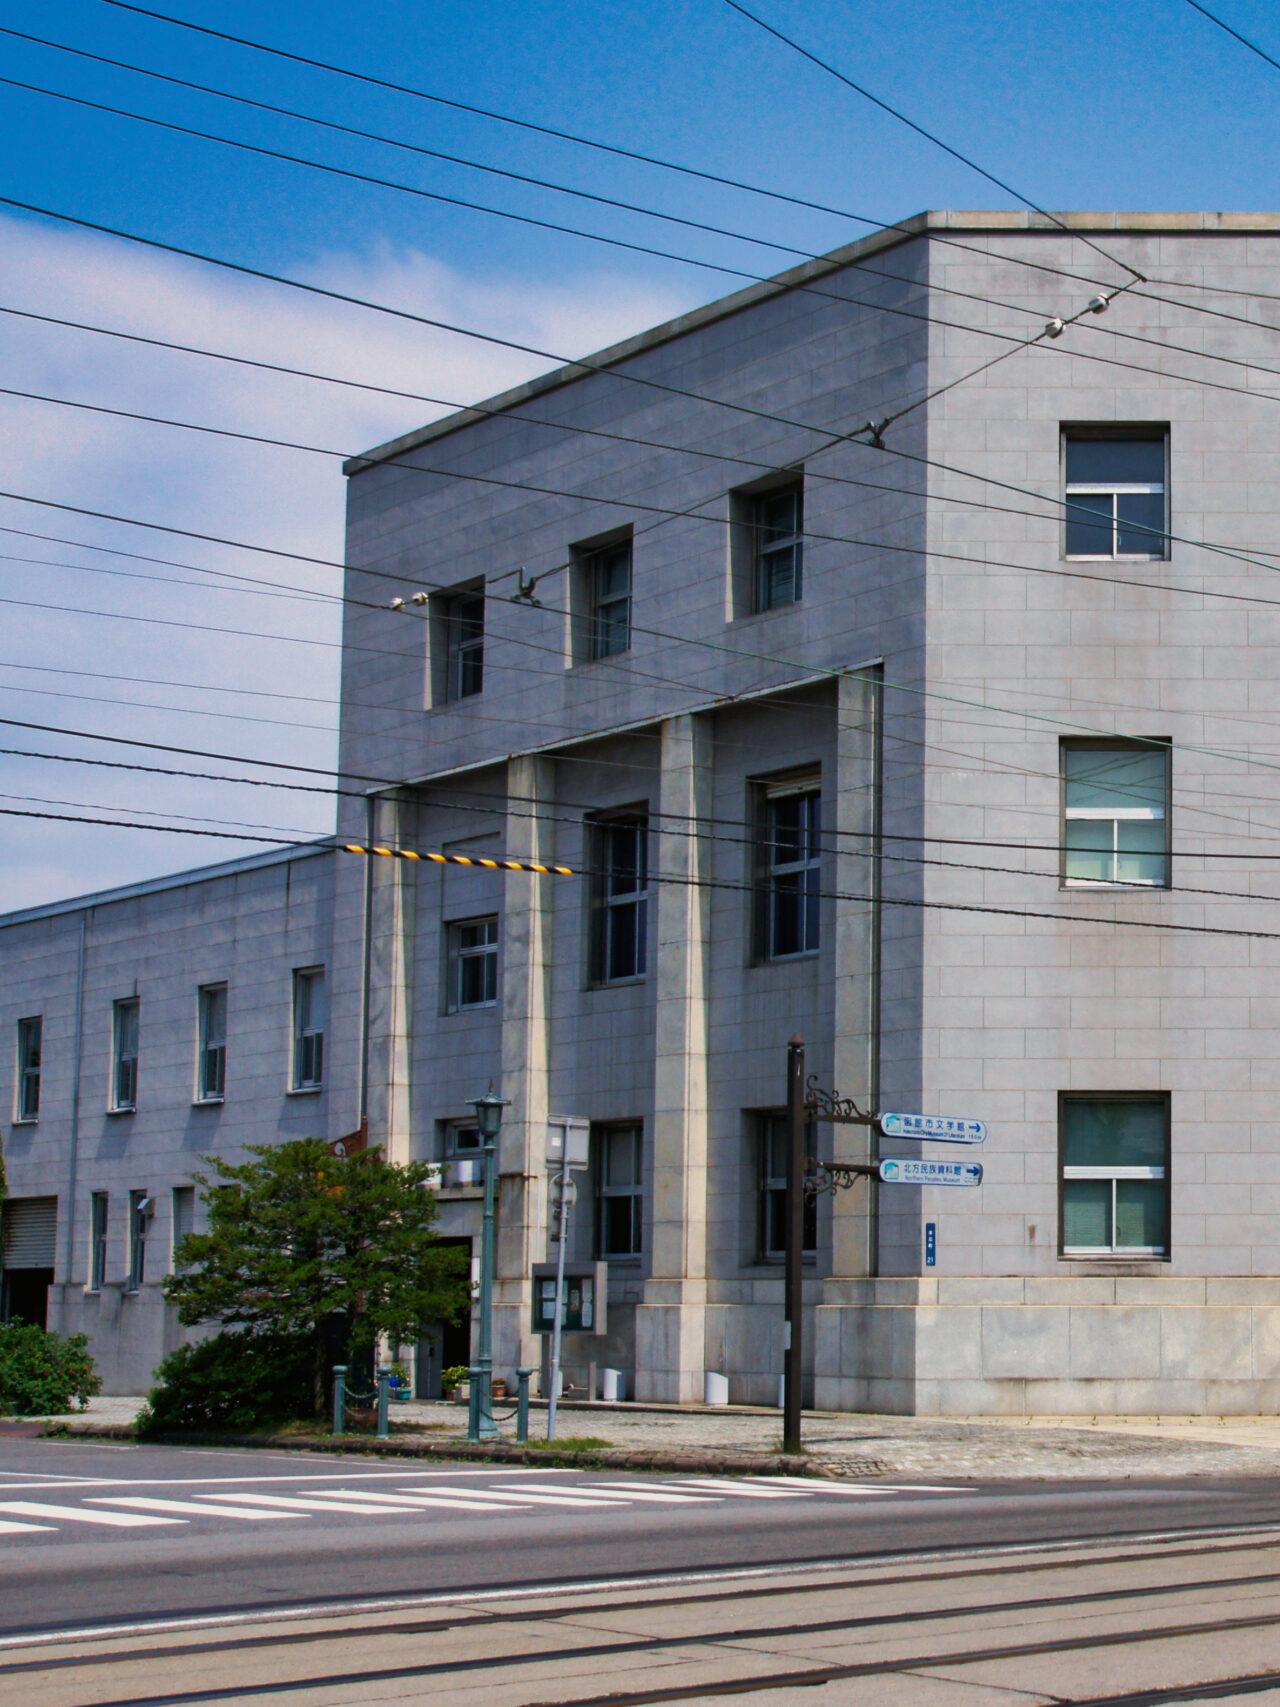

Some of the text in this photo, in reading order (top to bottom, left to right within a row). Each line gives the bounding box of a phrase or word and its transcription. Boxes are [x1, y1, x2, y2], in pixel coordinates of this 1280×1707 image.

[904, 1117, 965, 1132] 函館市文学館
[904, 1164, 962, 1176] 北方民族資料館
